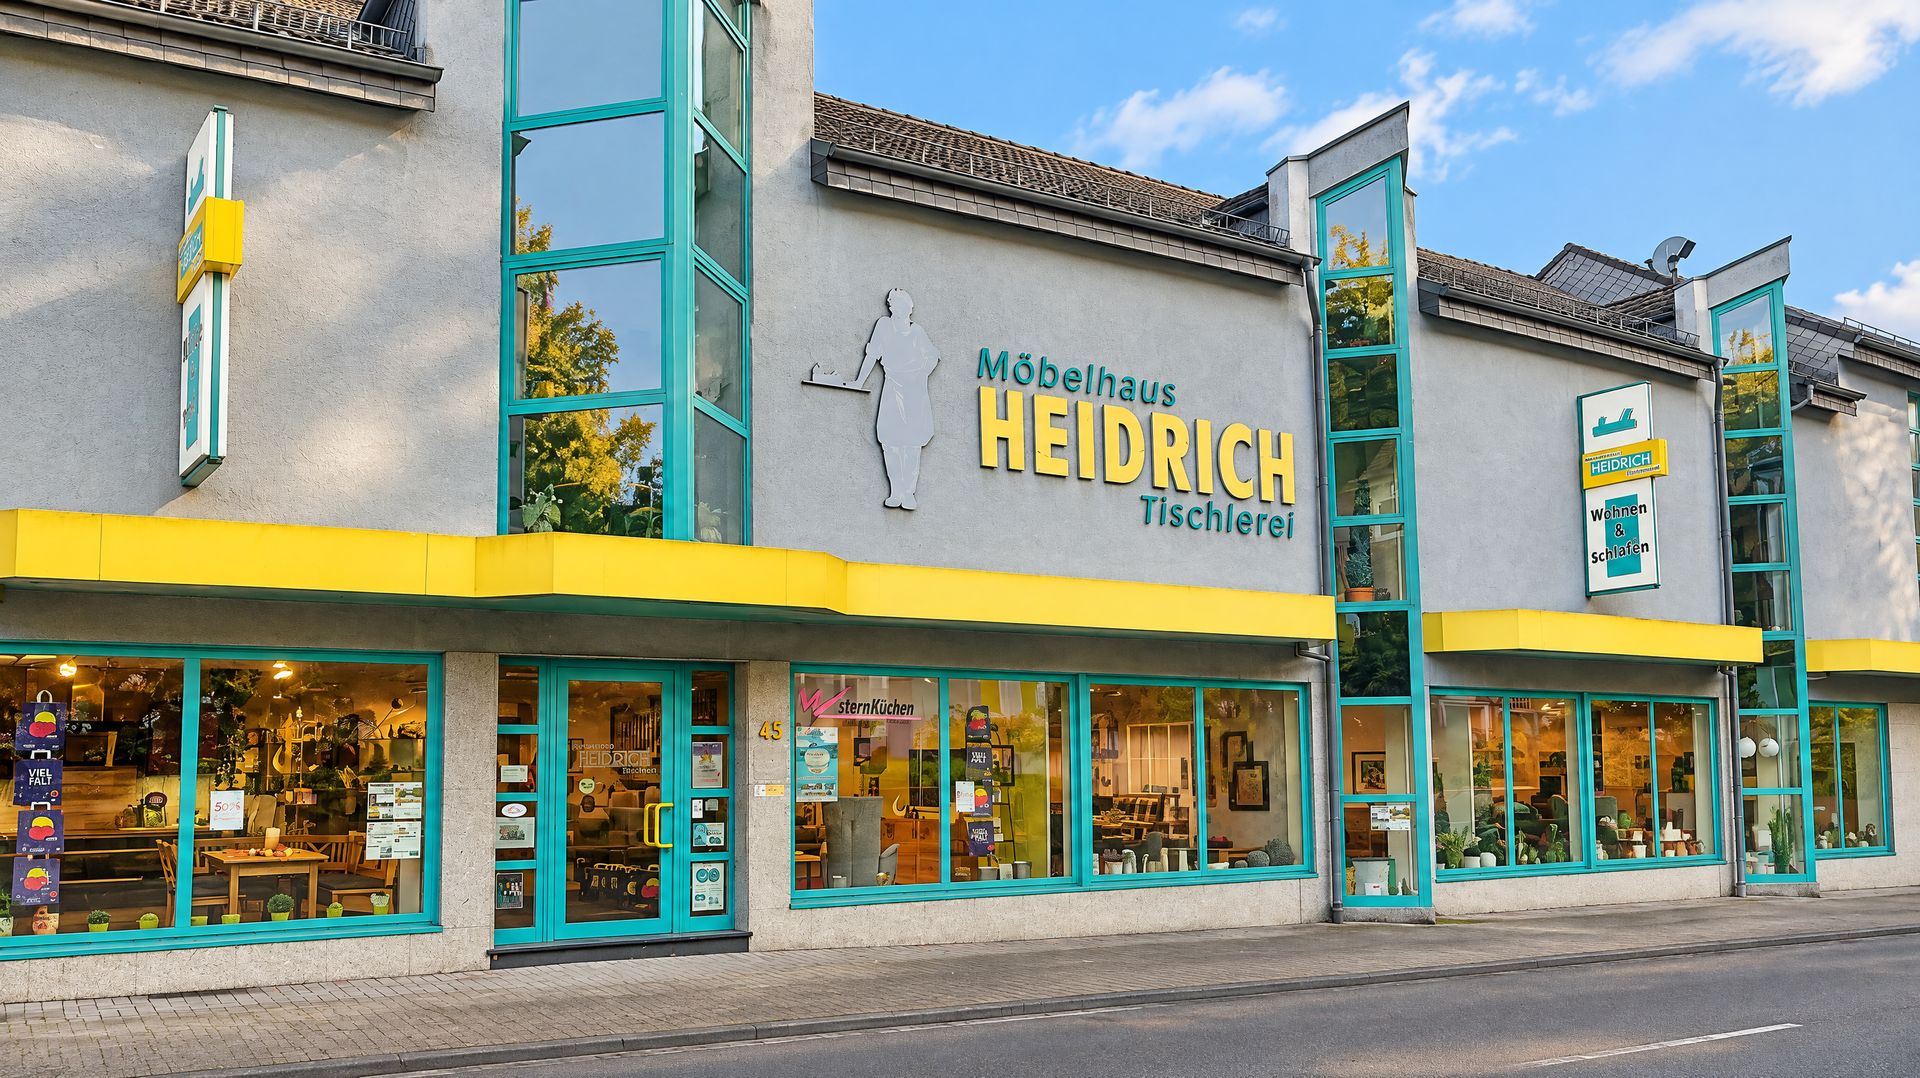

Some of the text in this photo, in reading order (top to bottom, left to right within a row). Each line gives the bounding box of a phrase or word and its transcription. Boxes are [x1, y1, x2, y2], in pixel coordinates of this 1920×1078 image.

[978, 347, 1176, 406] Möbelhaus
[978, 386, 1295, 505] HEIDRICH
[1592, 453, 1650, 474] HEIDRICH
[1141, 495, 1294, 538] Tischlerei
[1590, 502, 1647, 522] Wohnen
[1615, 523, 1625, 536] &
[1591, 541, 1649, 564] Schlafen
[759, 720, 783, 740] 45
[580, 750, 650, 767] HEIDRICH
[28, 768, 53, 777] VIEL
[28, 777, 53, 786] FALT
